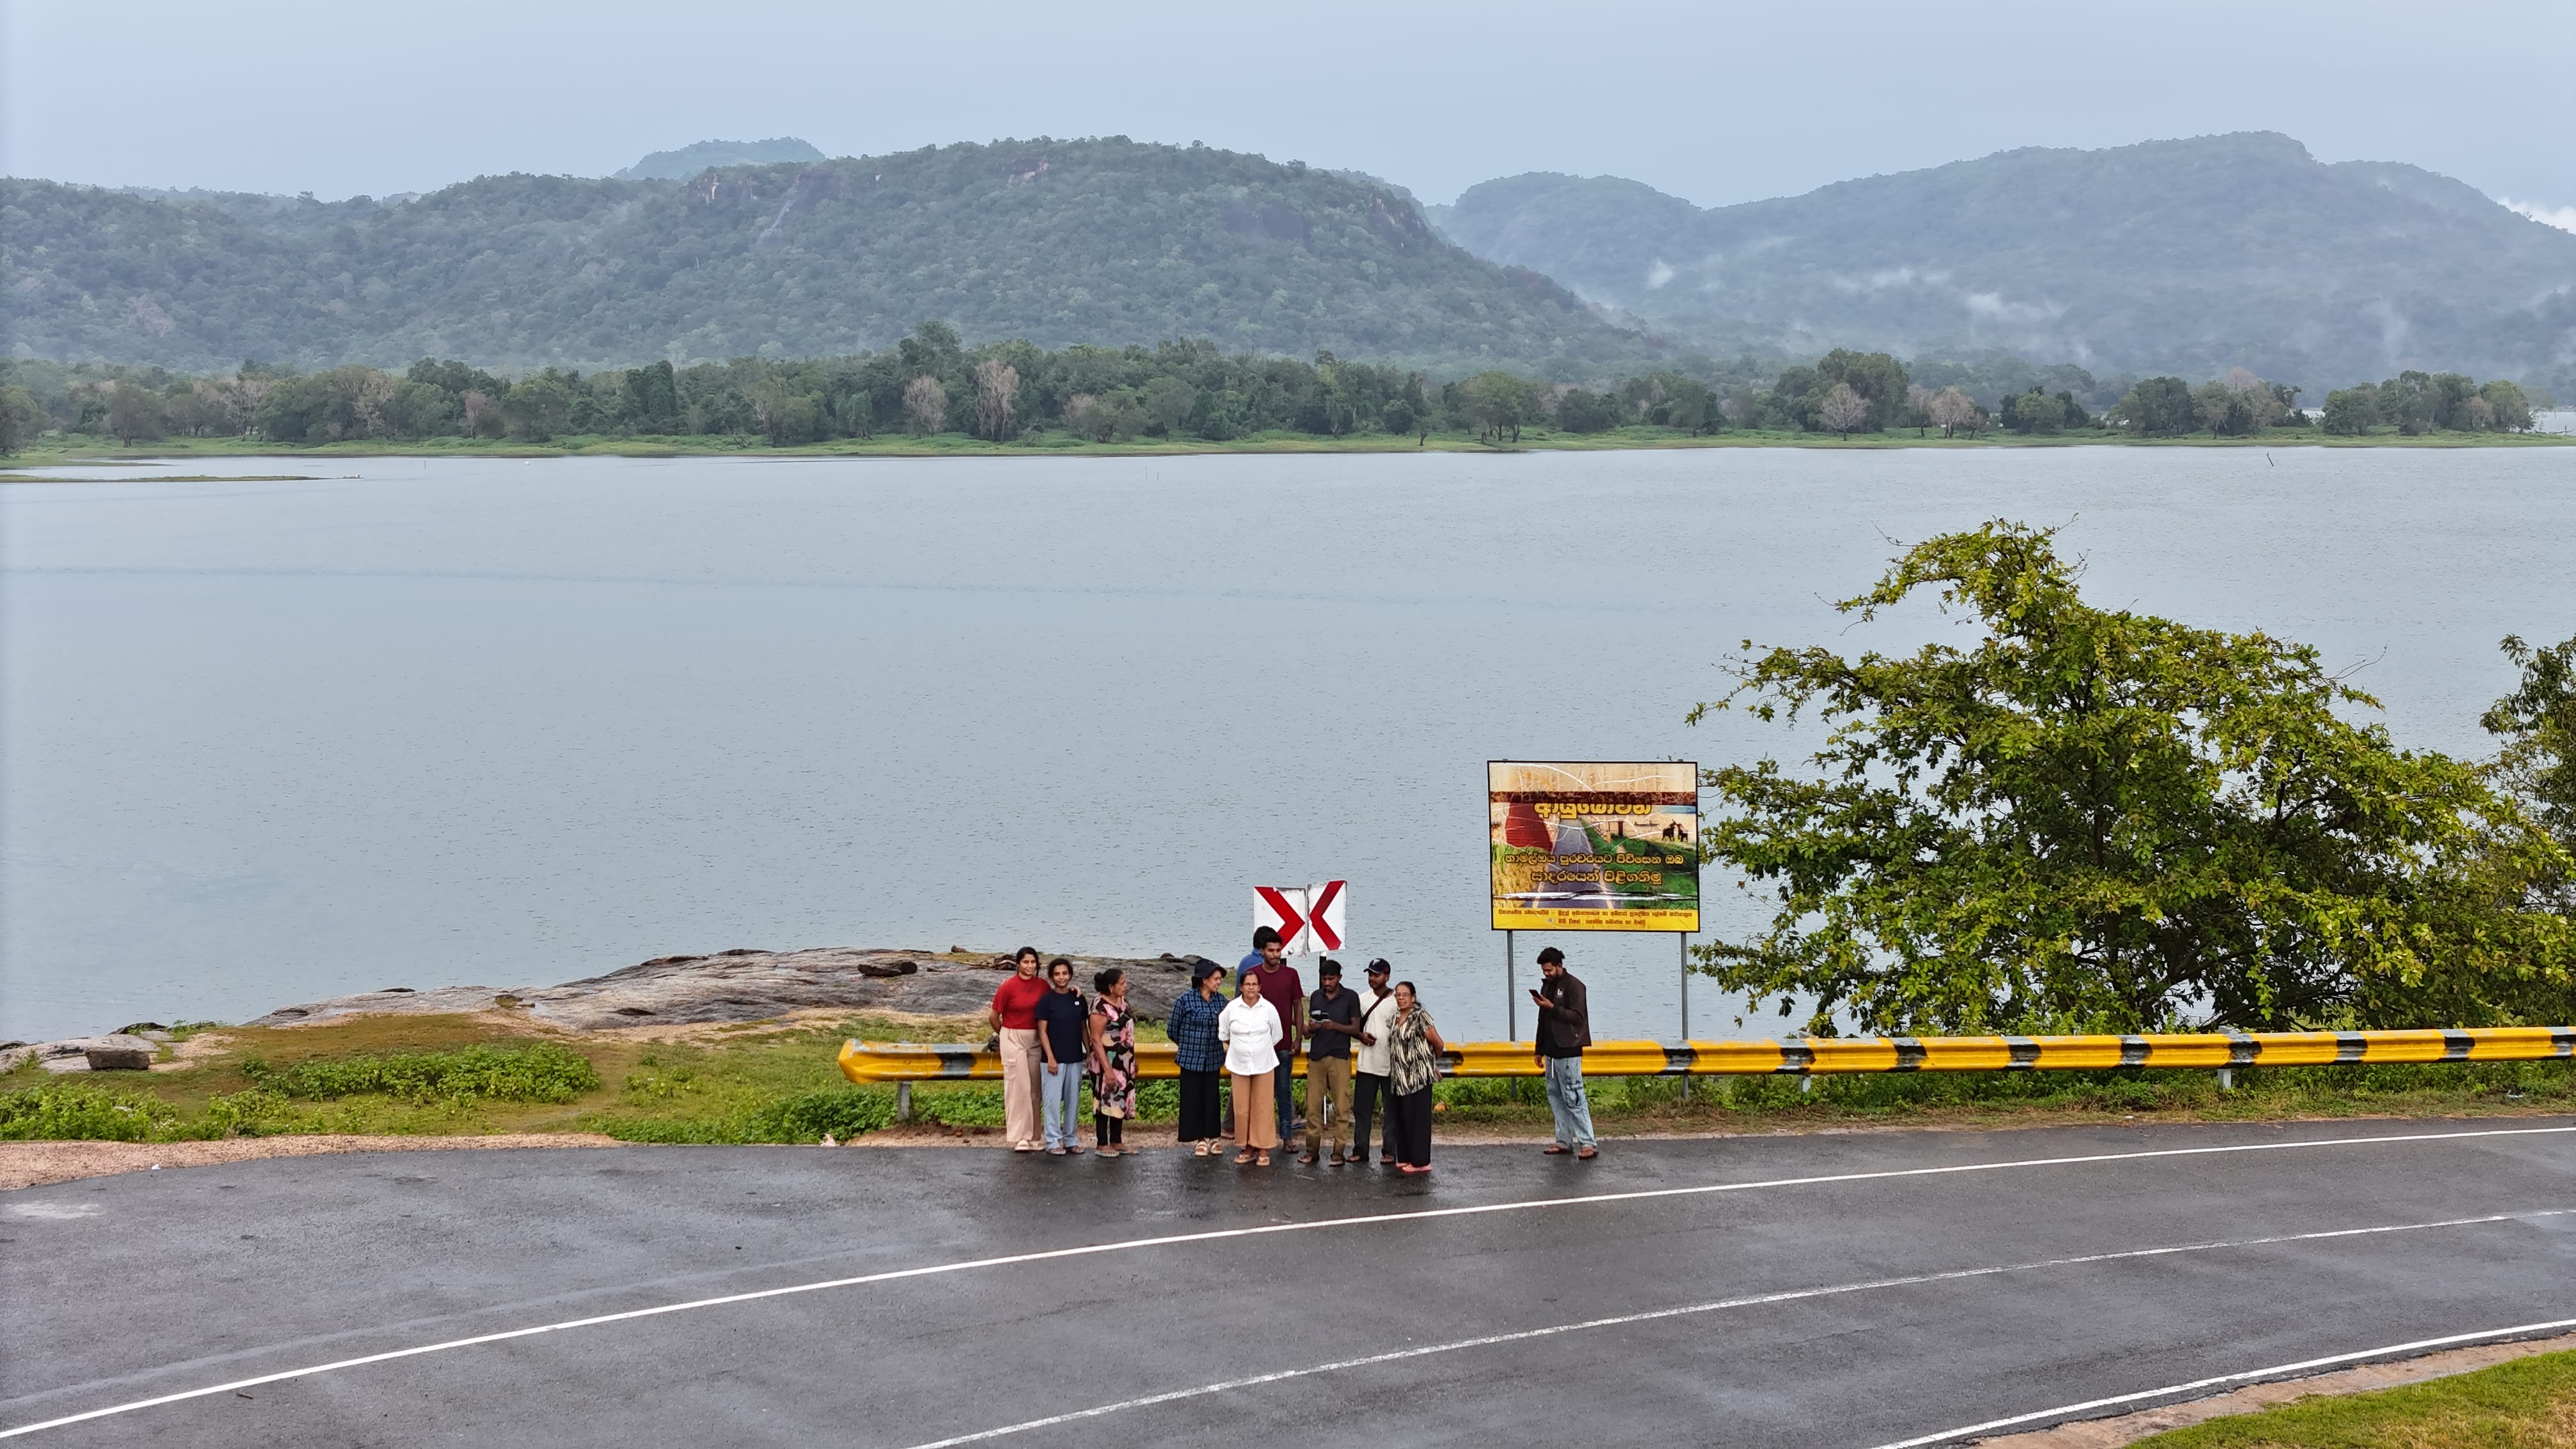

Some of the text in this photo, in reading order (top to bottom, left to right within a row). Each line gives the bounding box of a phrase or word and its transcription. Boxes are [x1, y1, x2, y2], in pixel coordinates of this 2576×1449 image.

[1559, 853, 1613, 866] පුරවරයට
[1616, 852, 1662, 864] පිවිසෙන
[1665, 854, 1684, 864] ඔබ
[1531, 868, 1662, 885] සාදරයෙන් පිළිගනිමු
